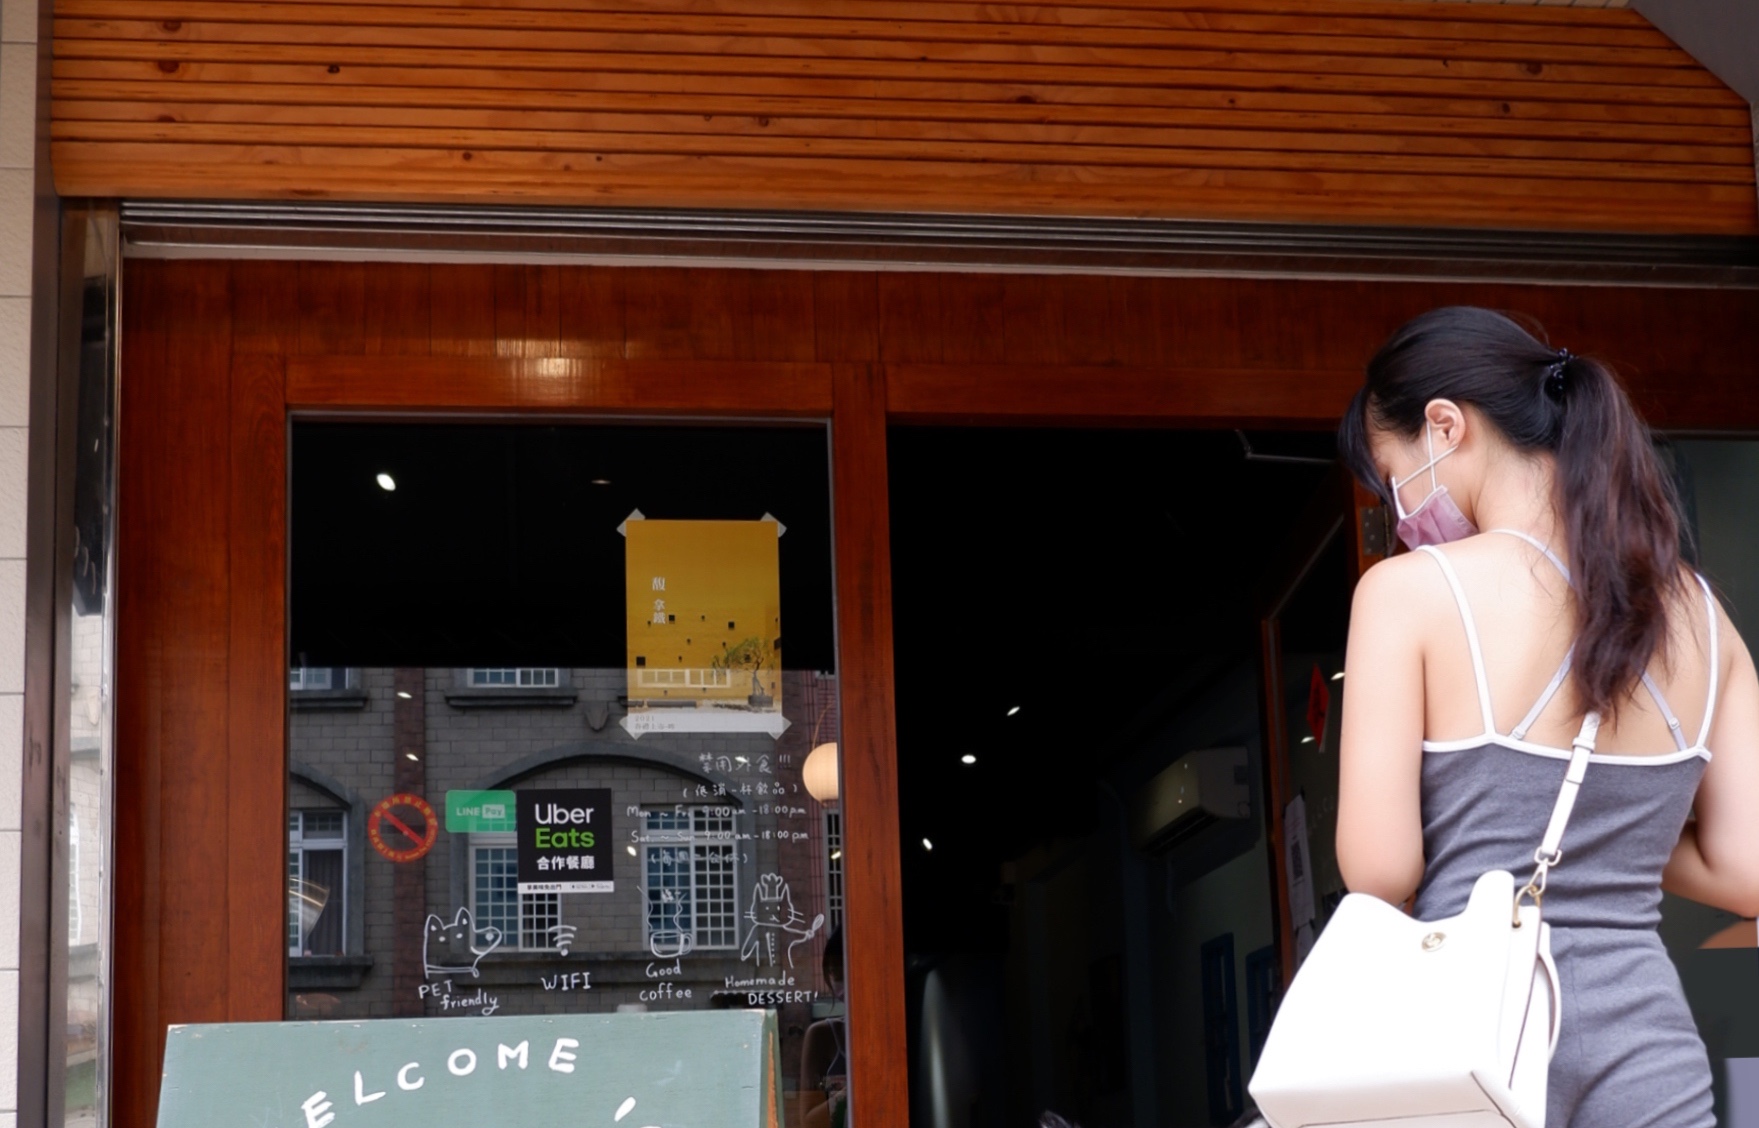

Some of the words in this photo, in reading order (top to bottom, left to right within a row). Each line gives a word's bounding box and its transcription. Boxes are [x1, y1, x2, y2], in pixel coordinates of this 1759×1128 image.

[456, 807, 480, 816] LINE
[484, 806, 503, 818] Pay
[534, 803, 595, 825] Uber
[535, 827, 595, 848] Eats
[536, 855, 595, 871] 合作餐廳
[645, 958, 682, 978] Good
[540, 972, 592, 991] WIFI
[724, 970, 796, 989] Homemade
[418, 980, 453, 999] PET
[639, 982, 693, 1002] coffee
[440, 988, 500, 1016] friendly
